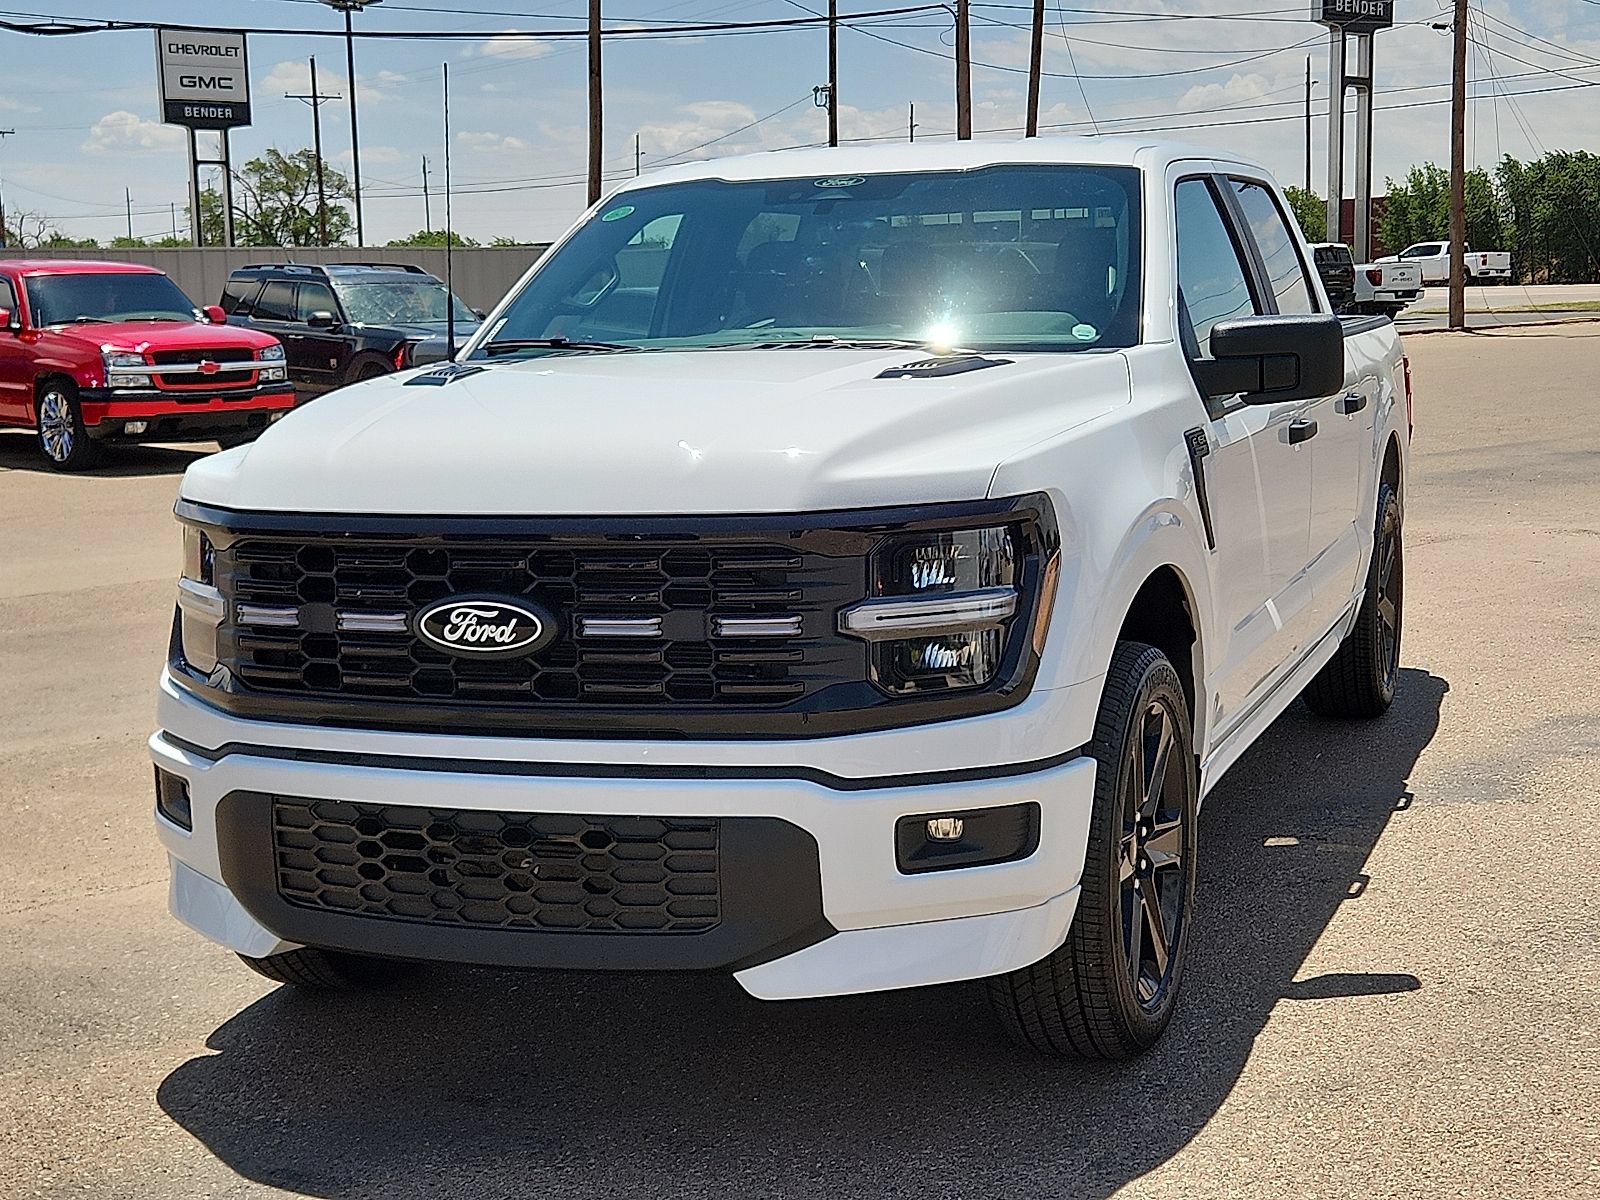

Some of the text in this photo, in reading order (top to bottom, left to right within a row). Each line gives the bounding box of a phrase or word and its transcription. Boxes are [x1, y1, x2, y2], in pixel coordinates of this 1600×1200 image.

[1336, 0, 1384, 16] BENDER
[168, 43, 240, 58] CHEVROLET
[179, 75, 233, 90] GMC
[184, 106, 233, 119] BENDER
[443, 607, 518, 643] Ford
